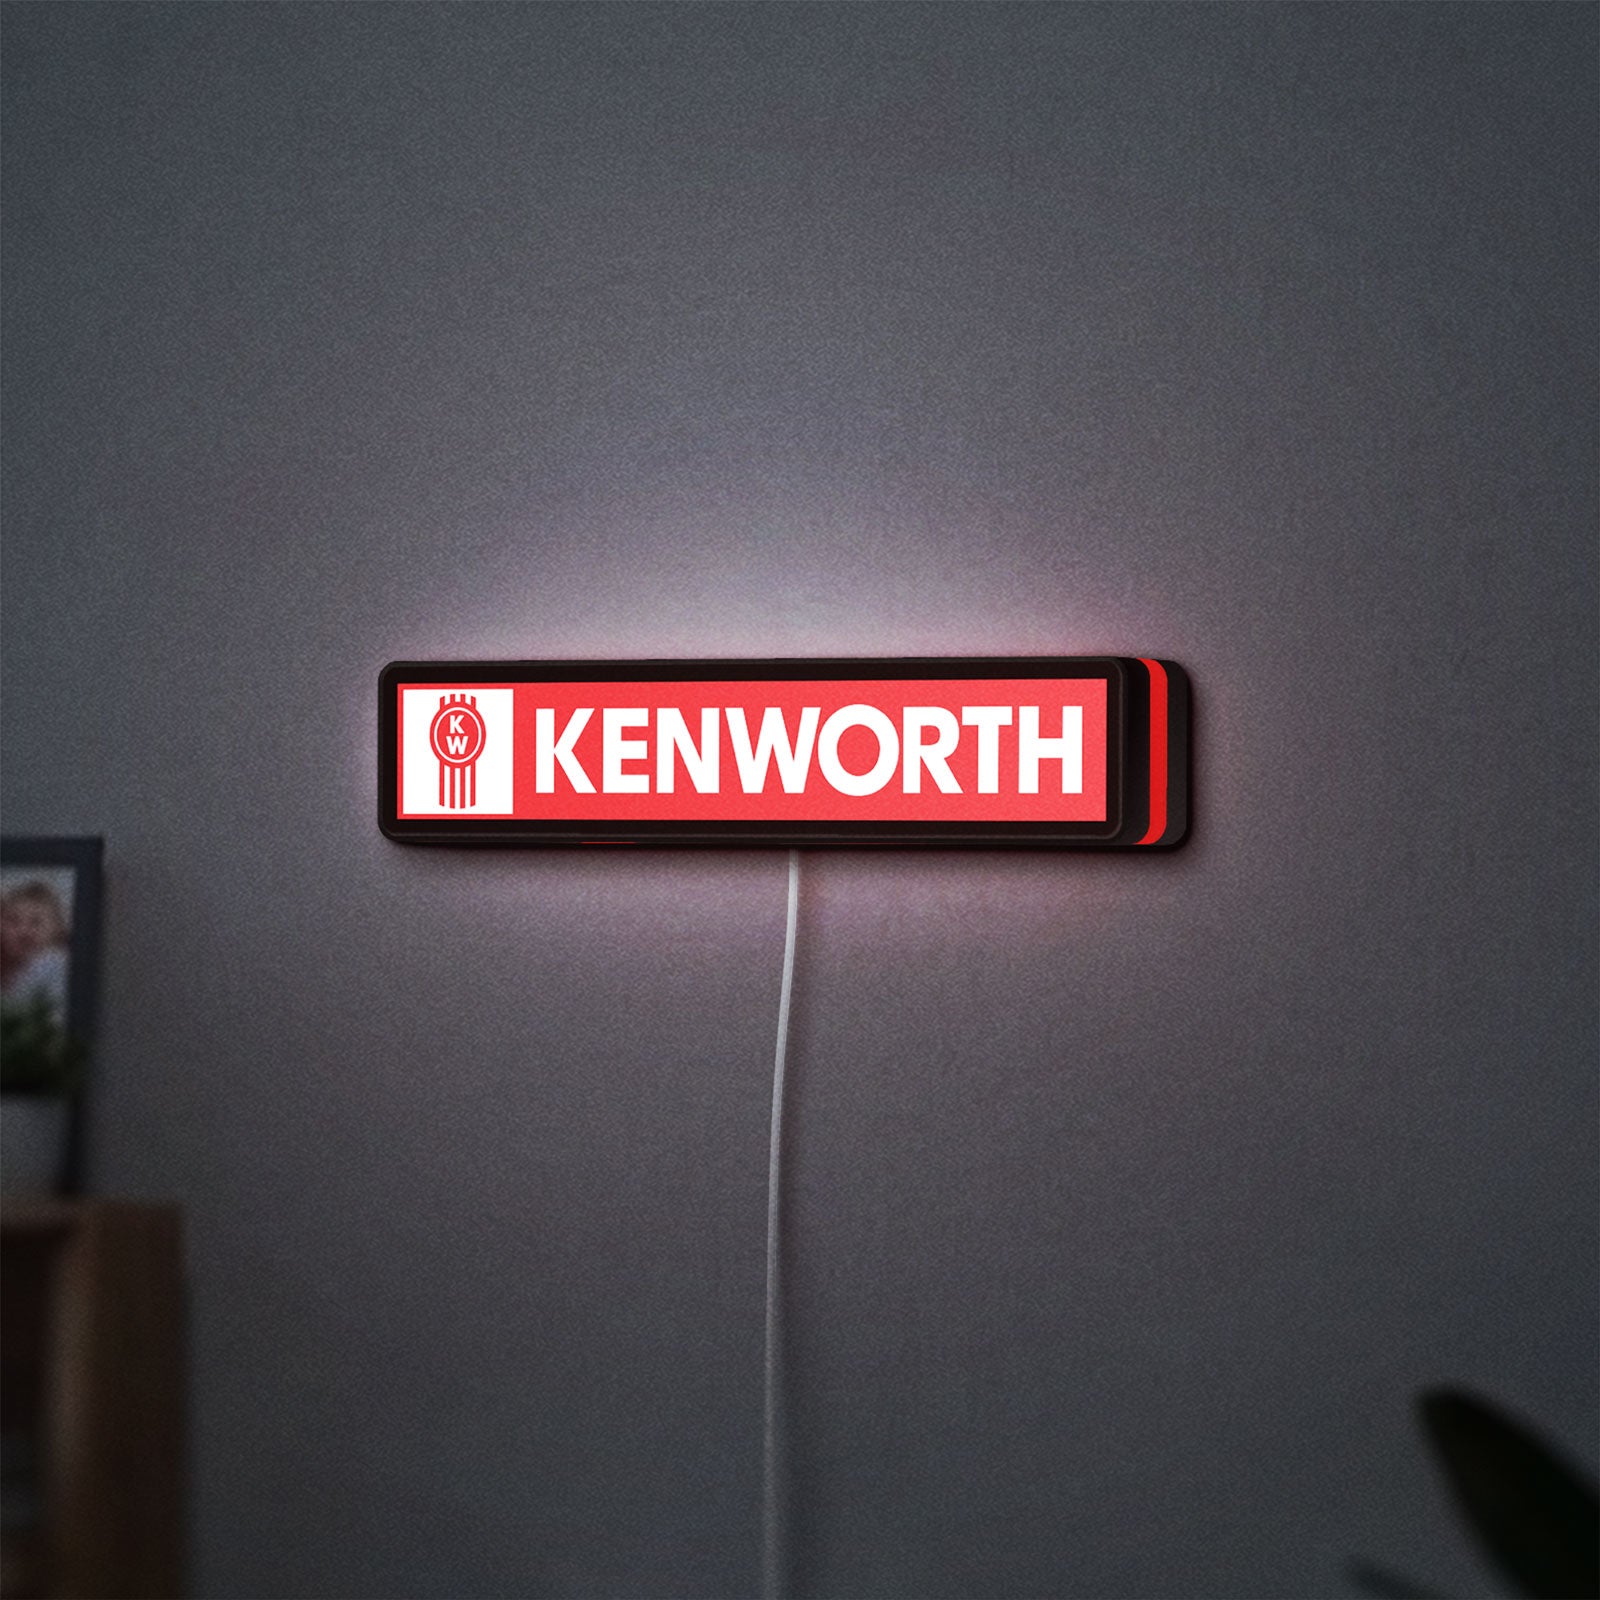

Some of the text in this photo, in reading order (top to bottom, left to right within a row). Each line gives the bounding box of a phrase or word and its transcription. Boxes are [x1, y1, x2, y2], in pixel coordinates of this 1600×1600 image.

[449, 714, 465, 734] K
[446, 735, 469, 755] W
[535, 703, 1083, 796] KENWORTH
